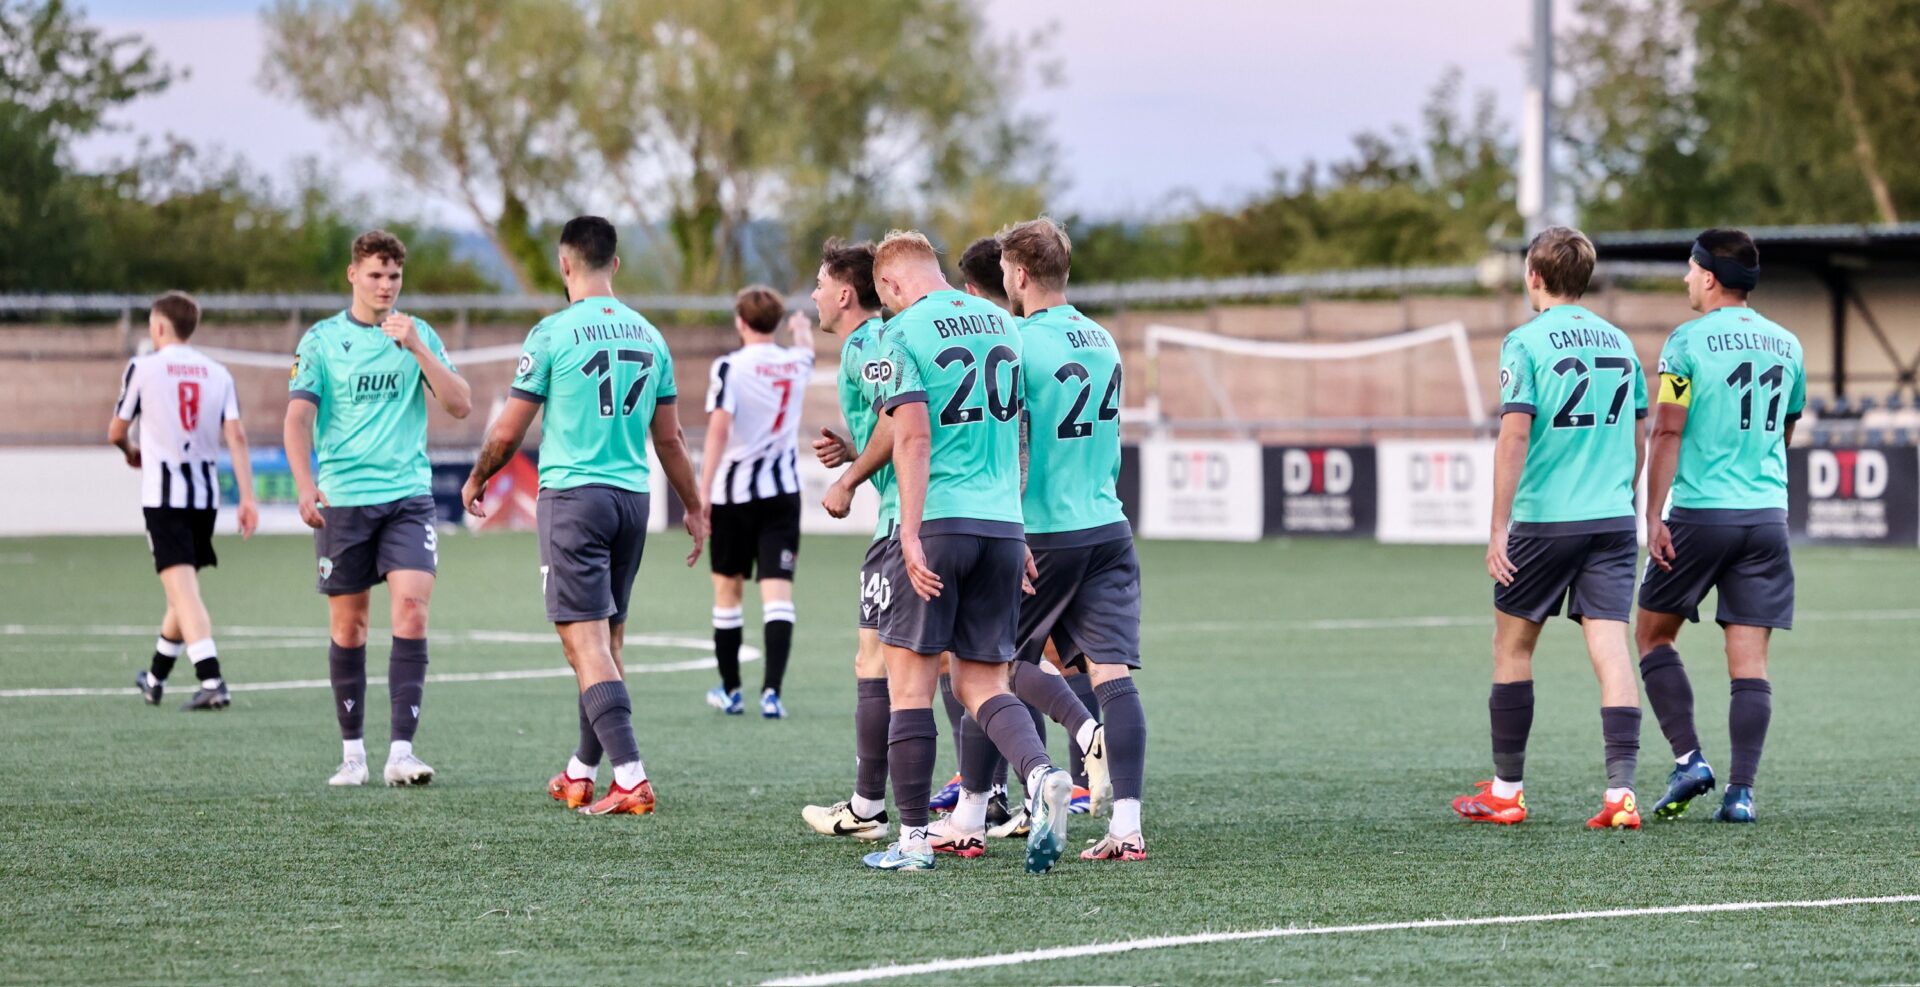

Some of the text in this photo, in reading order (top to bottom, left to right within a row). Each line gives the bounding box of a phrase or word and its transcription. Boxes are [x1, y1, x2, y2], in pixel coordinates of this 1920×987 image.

[573, 322, 653, 345] J WILLIAMS
[933, 314, 1006, 339] BRADLEY
[1066, 329, 1110, 348] BAKER
[1549, 328, 1622, 350] CANAVAN
[1707, 333, 1793, 359] CIESLEWICZ
[178, 381, 200, 432] 8
[356, 373, 399, 392] RUK
[580, 348, 655, 418] 17
[770, 380, 793, 434] 7
[933, 344, 1020, 427] 20
[1053, 361, 1123, 440] 24
[1551, 355, 1633, 429] 27
[1724, 361, 1785, 432] 11
[1282, 448, 1354, 496] DTD
[1807, 448, 1889, 500] DTD
